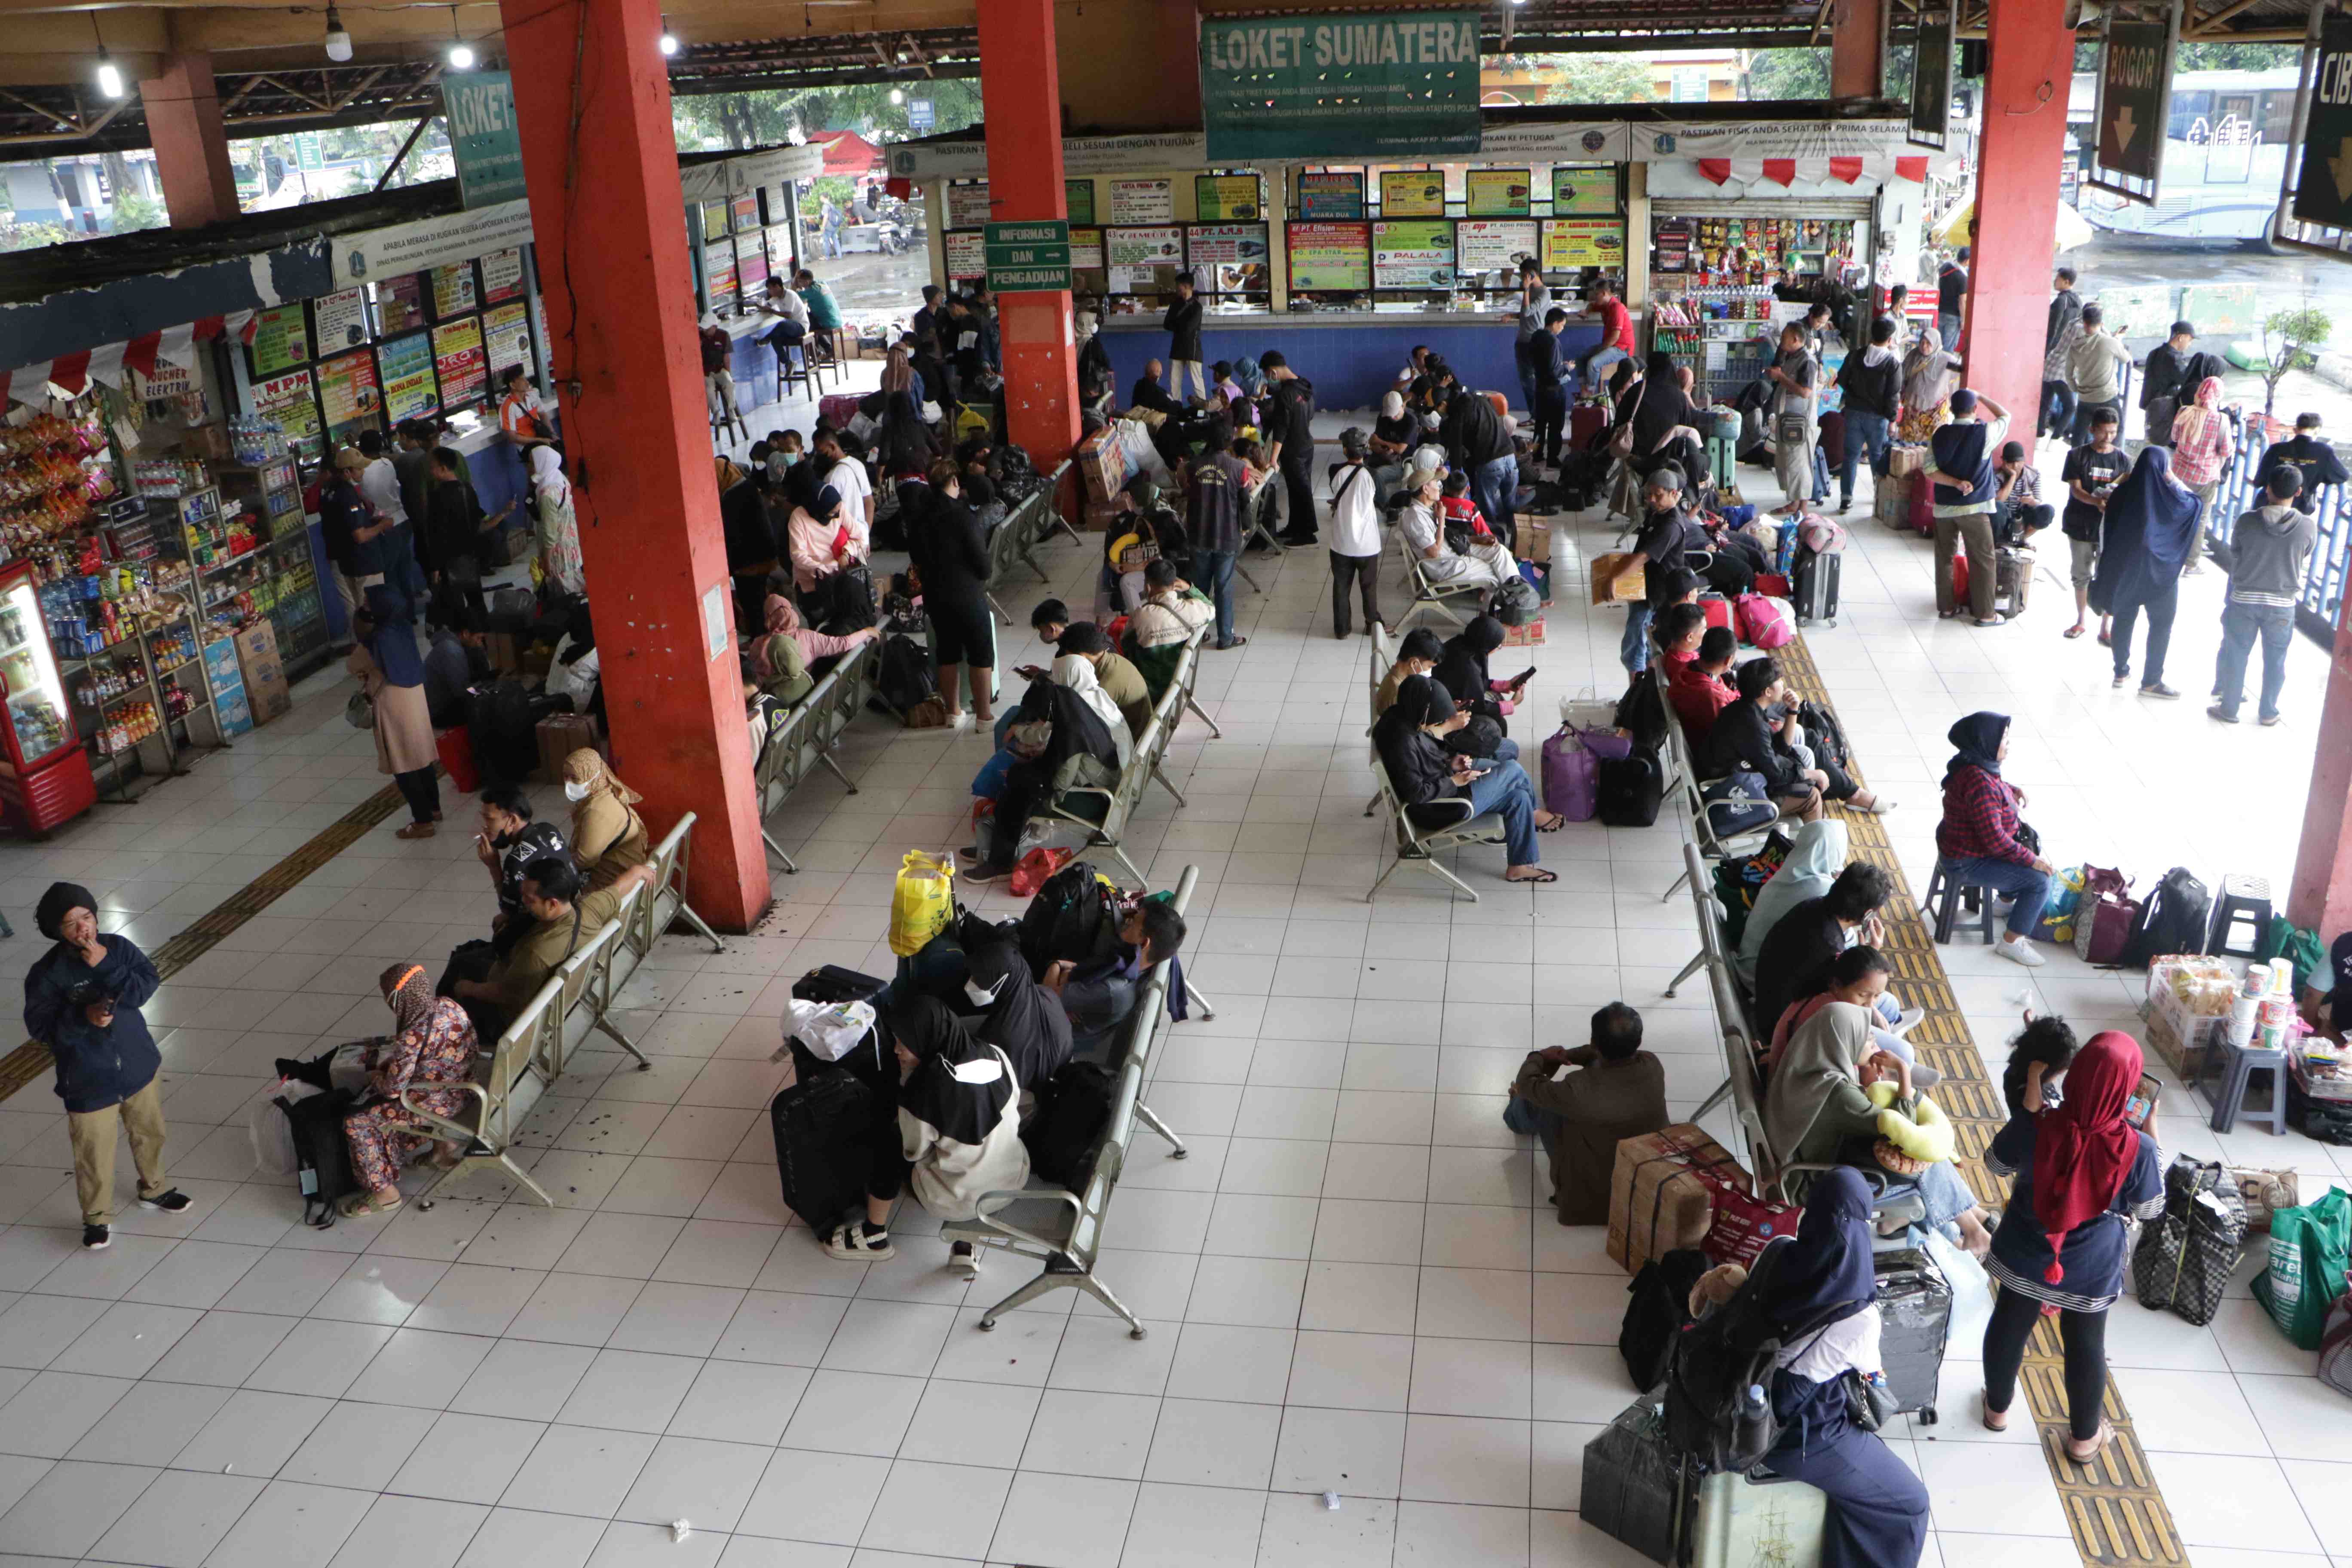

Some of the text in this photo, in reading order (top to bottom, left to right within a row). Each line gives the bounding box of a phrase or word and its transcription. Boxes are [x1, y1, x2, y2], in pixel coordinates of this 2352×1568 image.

[1210, 21, 1476, 70] LOKET SUMATERA
[2110, 46, 2154, 89] BOGOR
[451, 83, 510, 137] LOKET
[1681, 129, 1725, 138] PASTIKAN
[1752, 126, 1779, 134] ANDA
[1783, 124, 1811, 133] SEHAT
[1063, 137, 1195, 150] BELI SESUAI DENGAN TUJUAN
[935, 146, 978, 155] PASTIKAN
[998, 228, 1056, 241] INFORMASI
[1189, 228, 1199, 236] 44
[1375, 224, 1385, 233] 46
[383, 241, 406, 251] APABILA
[407, 235, 429, 246] MERASA
[947, 236, 957, 244] 41
[1012, 251, 1034, 263] DAN
[993, 270, 1065, 284] PENGADUAN
[265, 372, 309, 396] MPM
